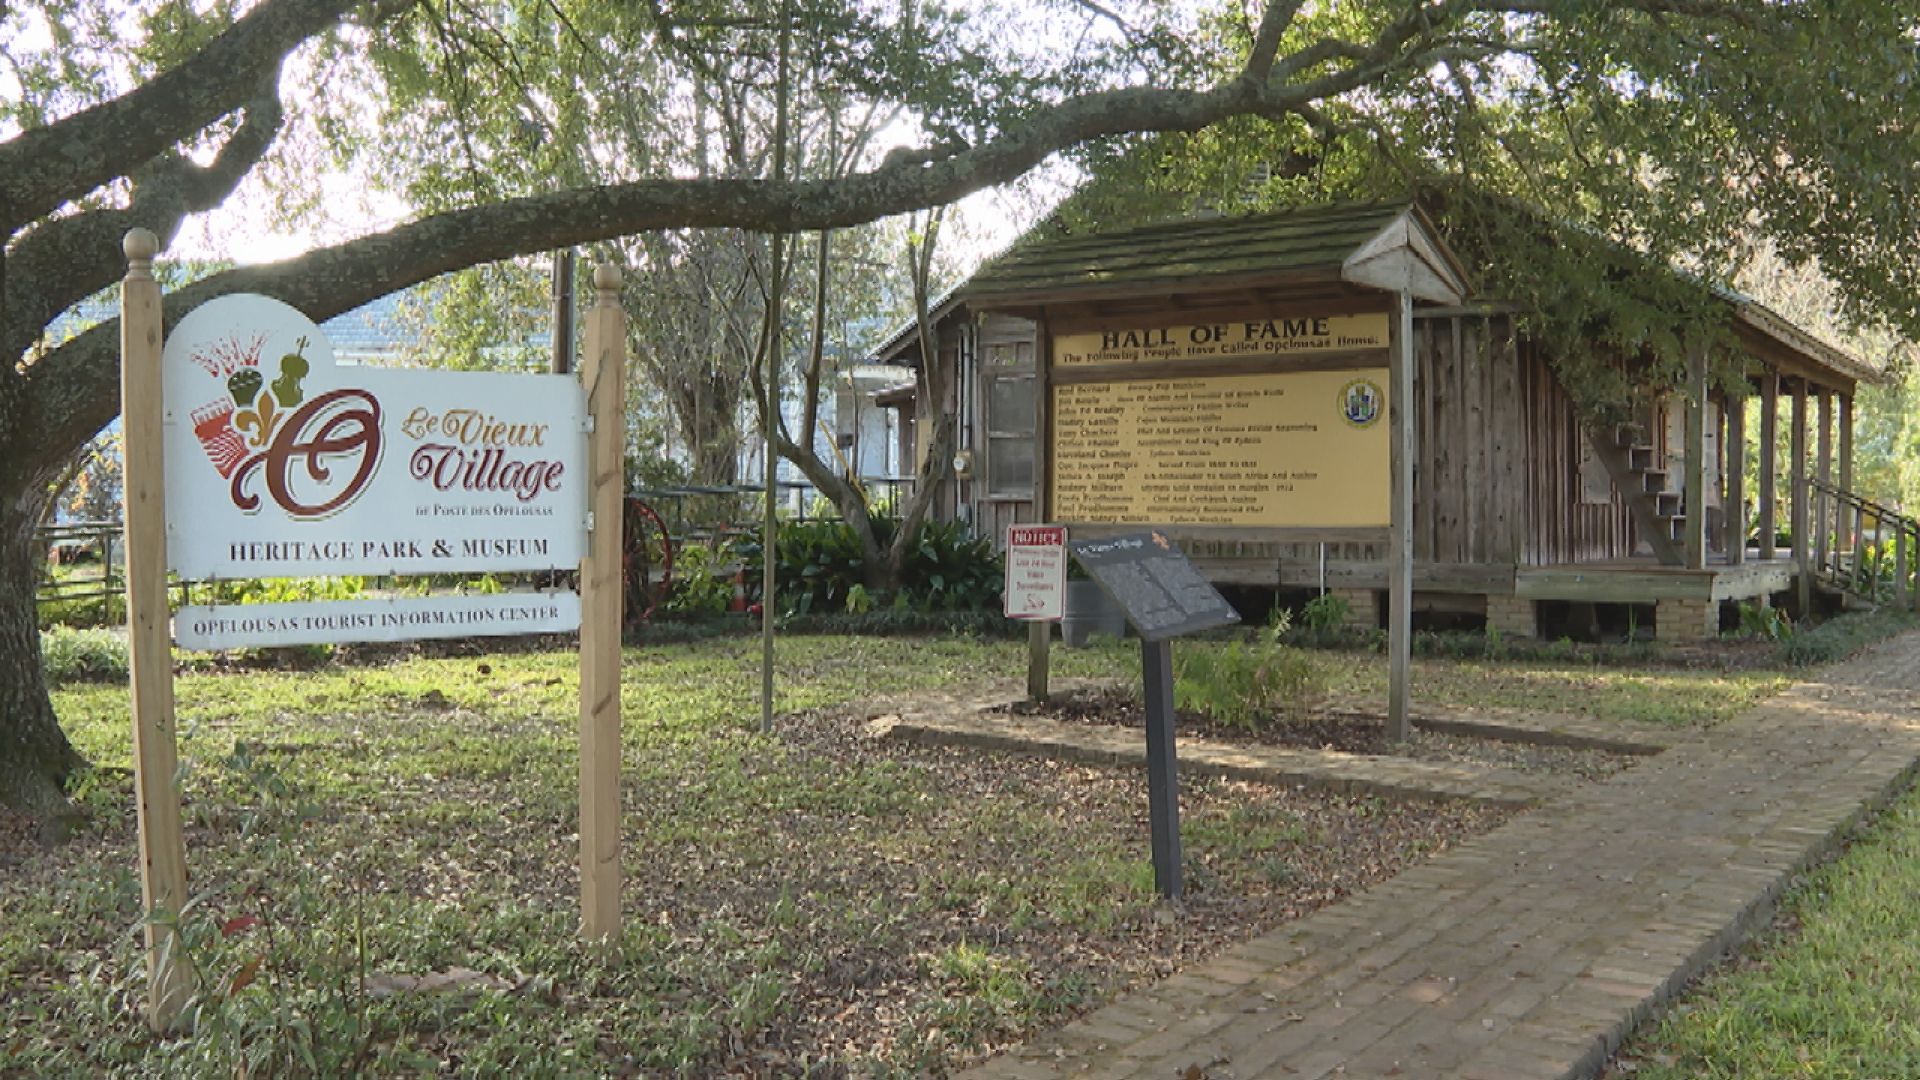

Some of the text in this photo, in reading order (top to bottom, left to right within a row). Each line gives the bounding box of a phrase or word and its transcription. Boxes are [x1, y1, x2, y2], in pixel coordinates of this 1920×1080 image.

[1102, 317, 1330, 349] HALL OF FAME
[1063, 353, 1082, 363] The
[1086, 350, 1139, 363] Following
[1220, 342, 1259, 354] Called
[401, 406, 549, 447] Le Vieux
[409, 443, 565, 502] Village
[230, 539, 548, 561] HERITAGE PARK & MUSEUM
[1015, 531, 1060, 546] NOTICE
[194, 605, 559, 636] OPELOUSAS TOURIST INFORMATION CENTER
